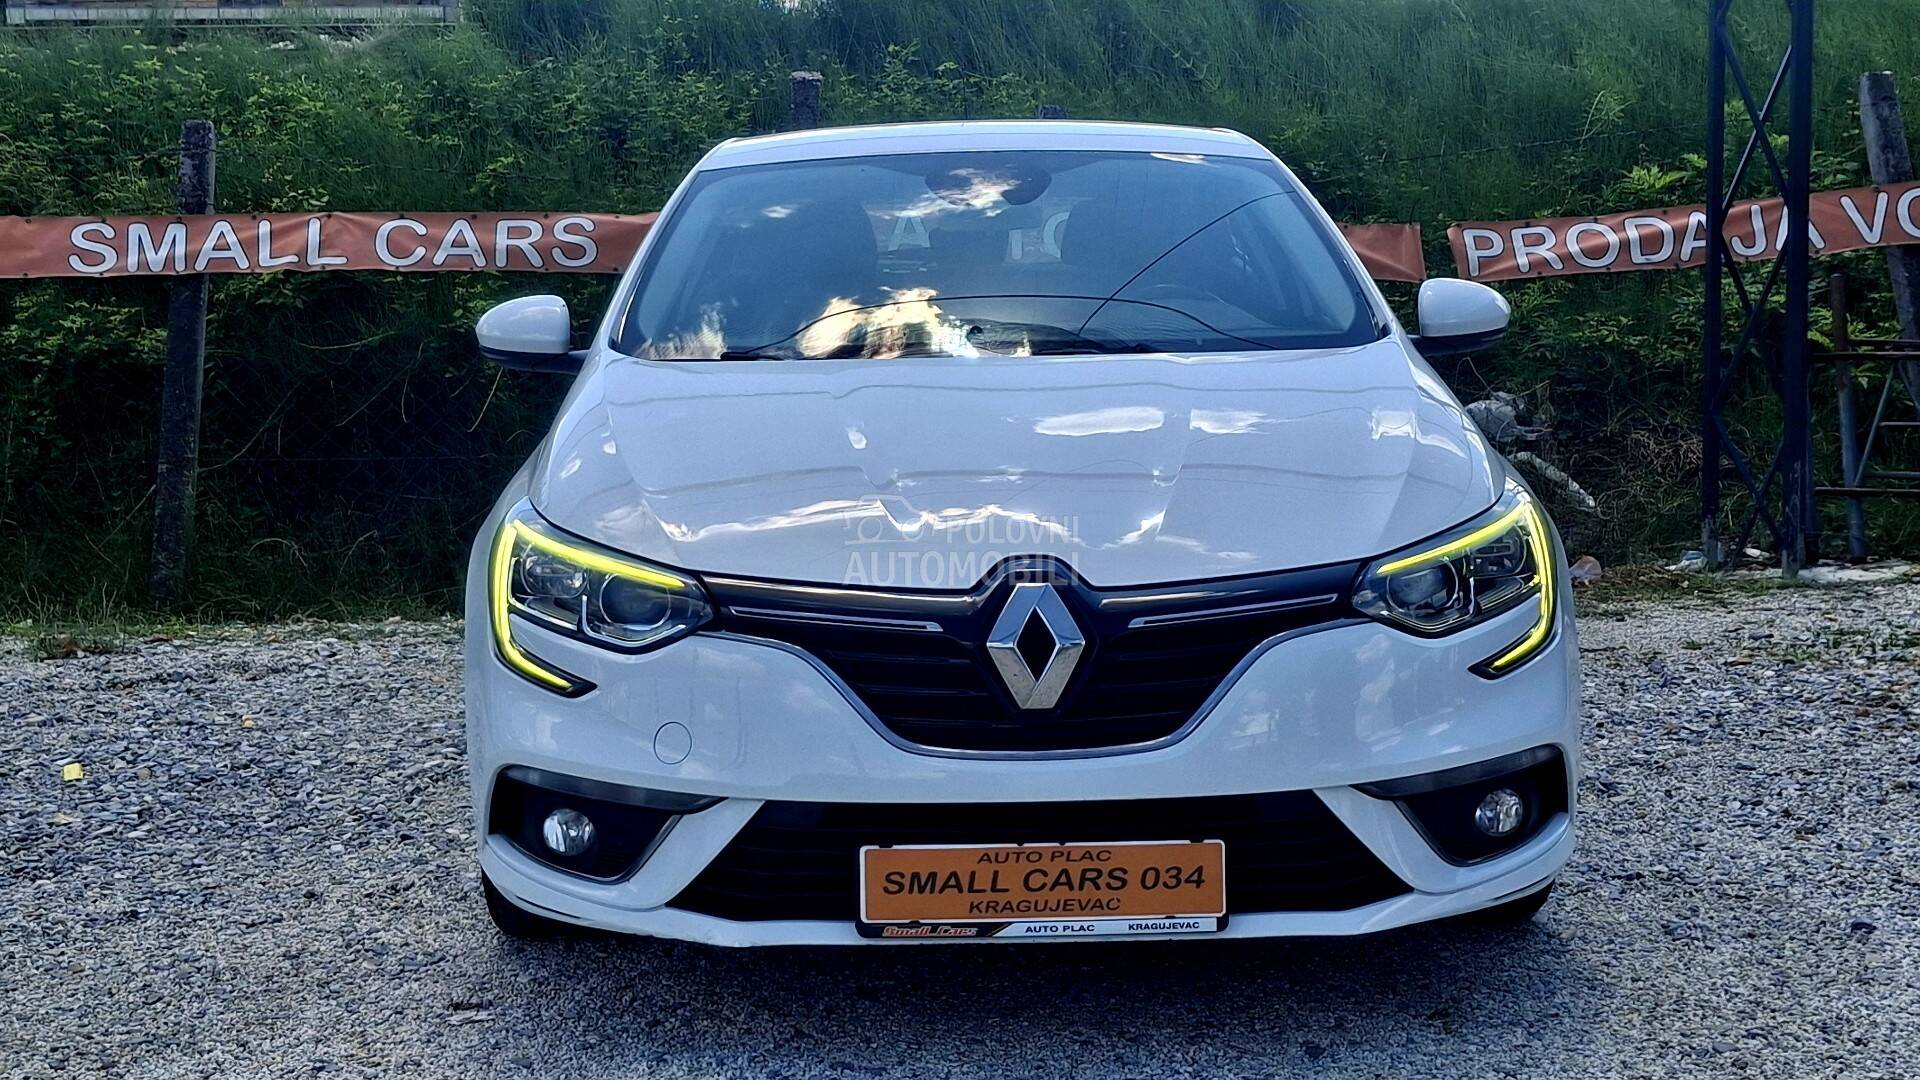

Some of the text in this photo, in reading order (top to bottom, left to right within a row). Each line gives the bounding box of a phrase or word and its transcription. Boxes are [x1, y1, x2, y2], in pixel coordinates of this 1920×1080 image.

[68, 216, 599, 274] SMALL CARS
[977, 849, 1112, 864] AUTO PLAC
[882, 865, 1206, 895] SMALL CARS 034
[969, 897, 1121, 914] KRAGUJEVAC
[1025, 923, 1096, 933] AUTO PLAC
[1128, 920, 1200, 931] KRAGUJEVAC
